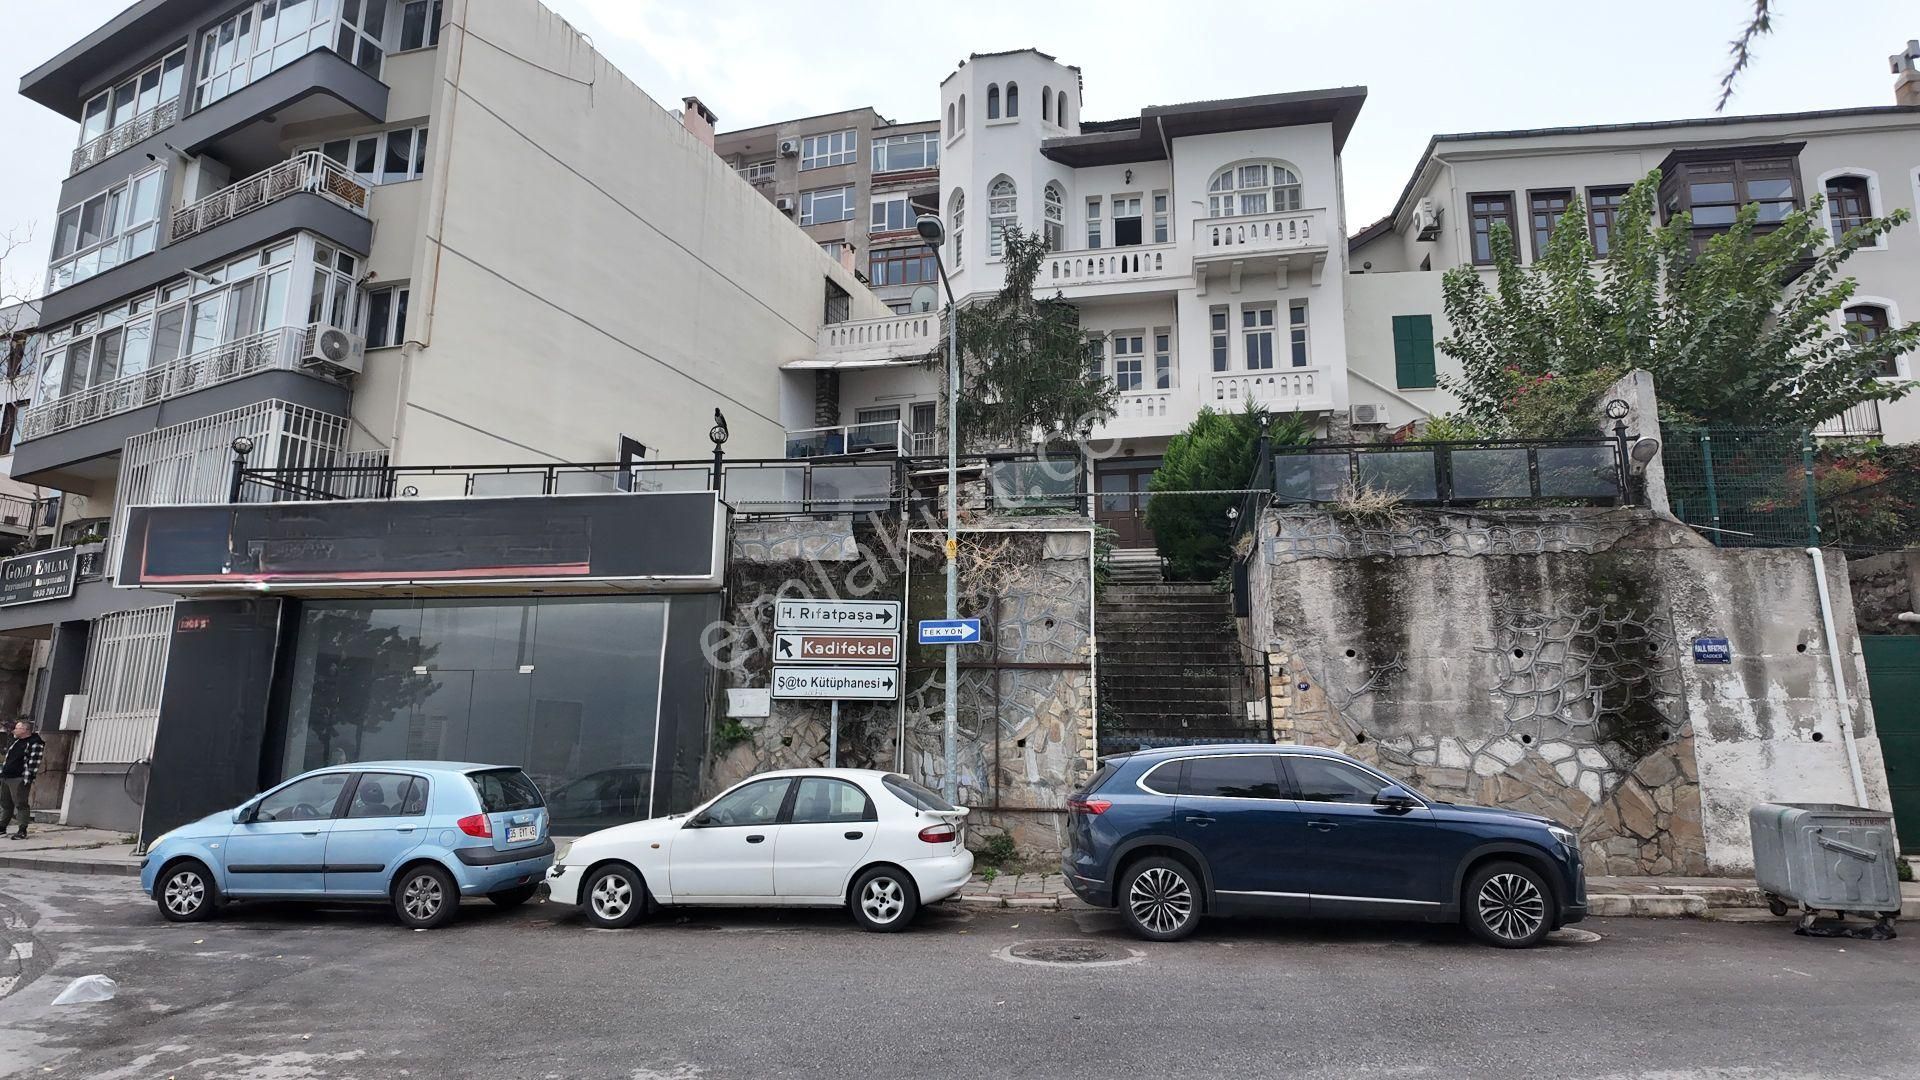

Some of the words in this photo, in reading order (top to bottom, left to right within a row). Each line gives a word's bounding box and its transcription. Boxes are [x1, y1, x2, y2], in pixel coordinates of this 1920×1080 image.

[6, 564, 32, 580] GOLD
[35, 559, 69, 575] EMLAK
[782, 607, 795, 618] H.
[800, 607, 873, 622] Rıfatpaşa
[803, 640, 892, 655] Kadifekale
[778, 676, 807, 690] Ş@to
[811, 677, 881, 690] Kütüphanesi
